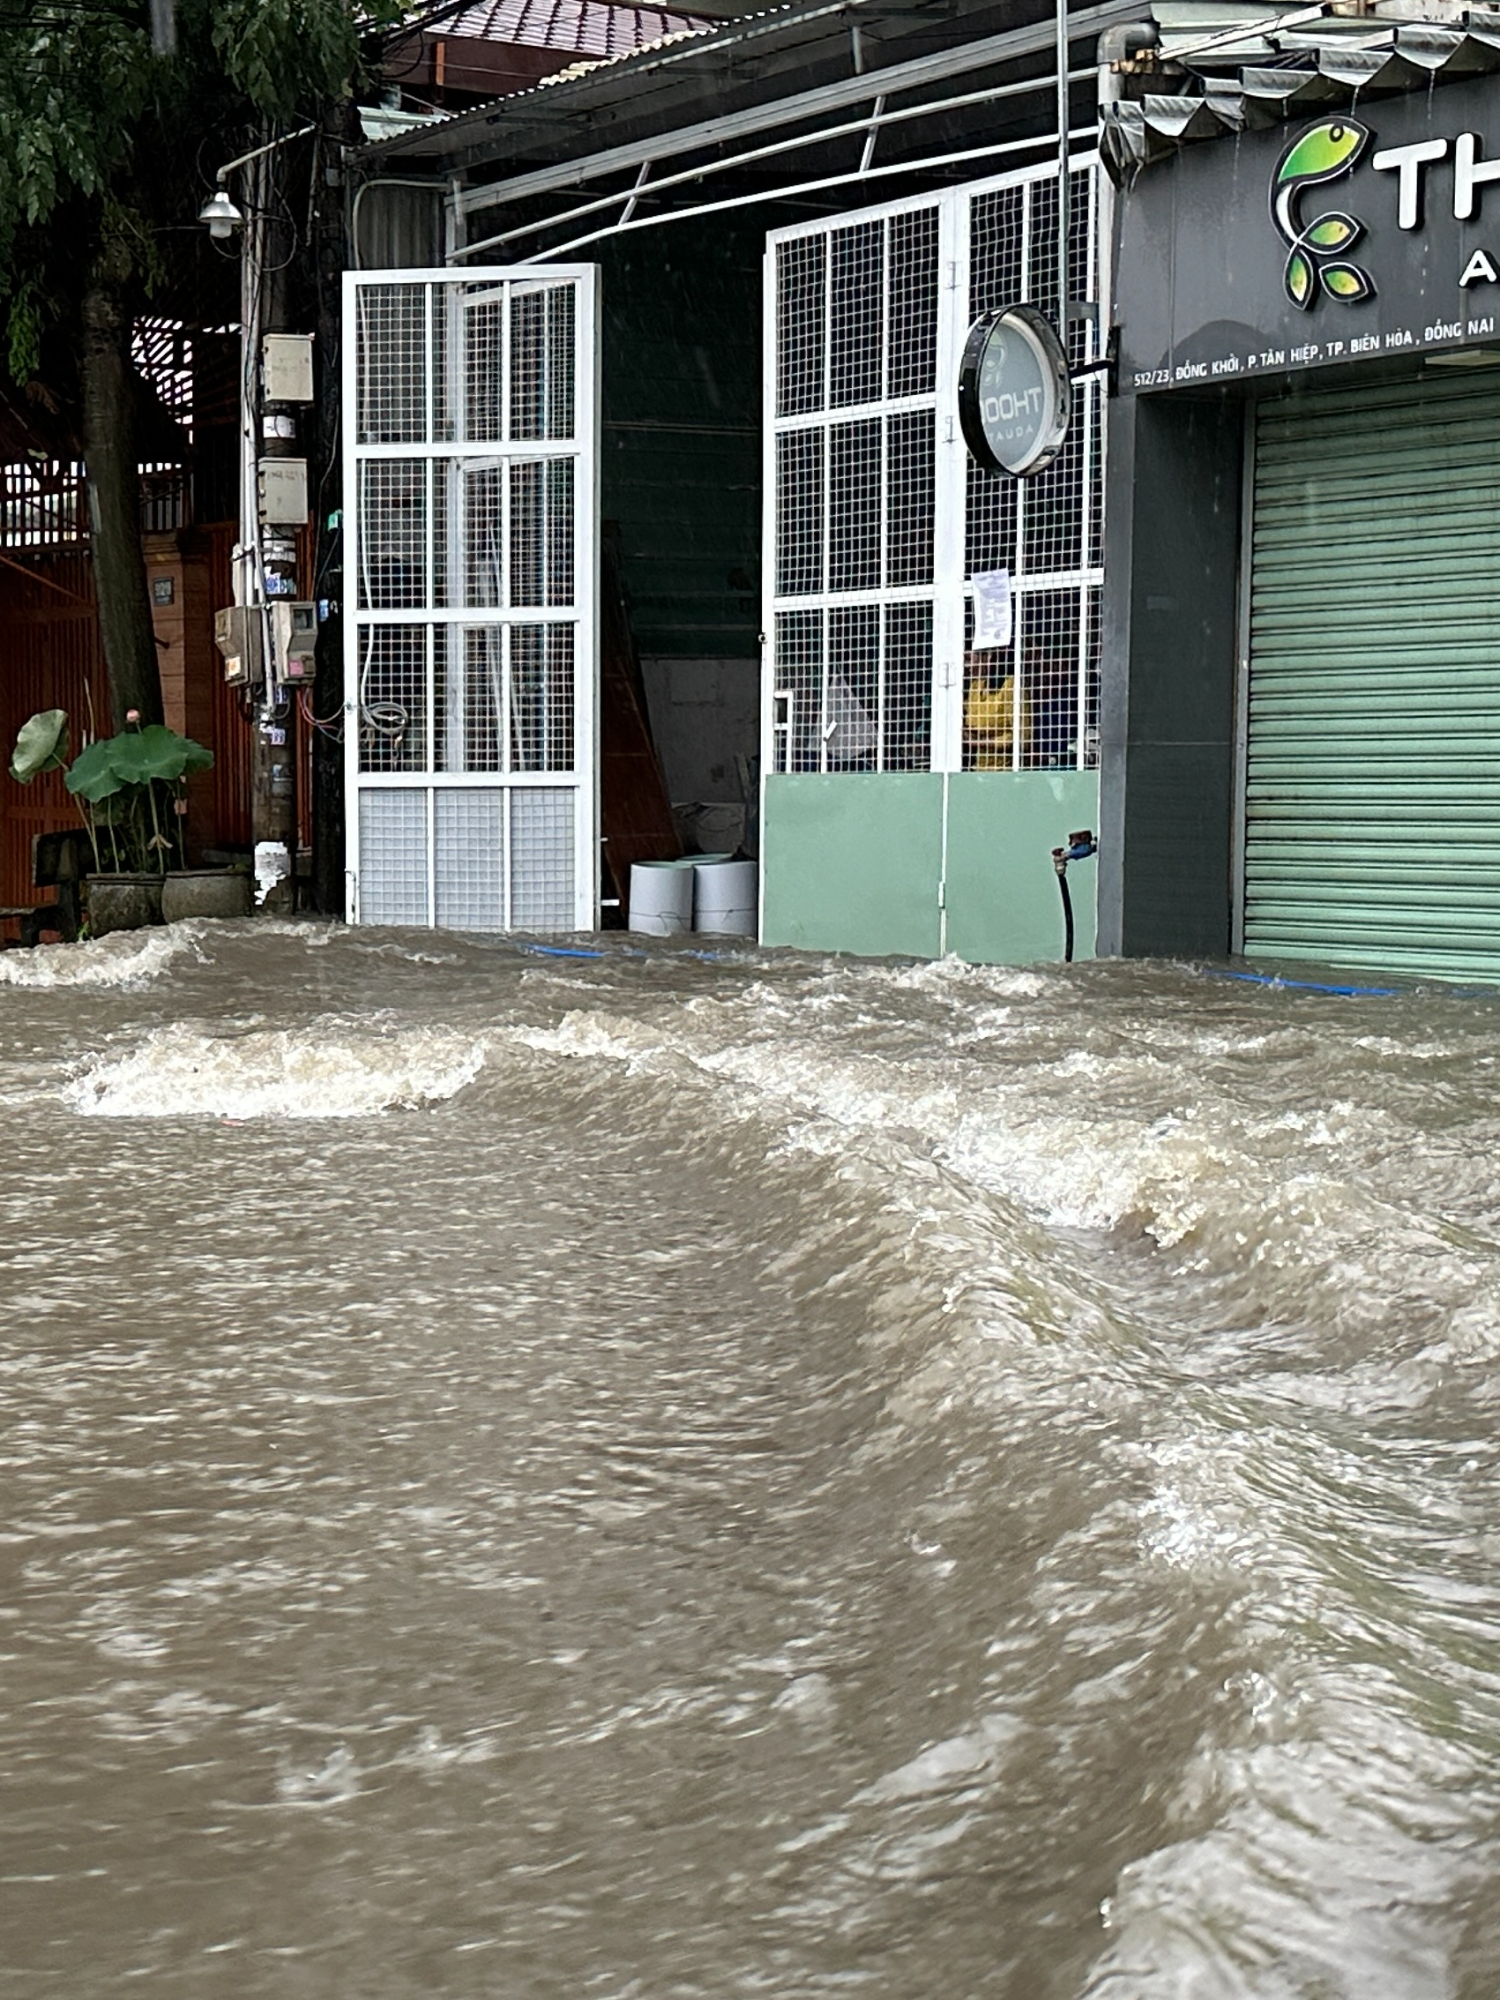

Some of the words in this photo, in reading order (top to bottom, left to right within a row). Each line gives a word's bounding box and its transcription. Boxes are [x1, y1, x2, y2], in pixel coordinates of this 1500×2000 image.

[1459, 250, 1497, 287] A
[1326, 341, 1347, 357] TP.
[1467, 317, 1494, 336] NAI
